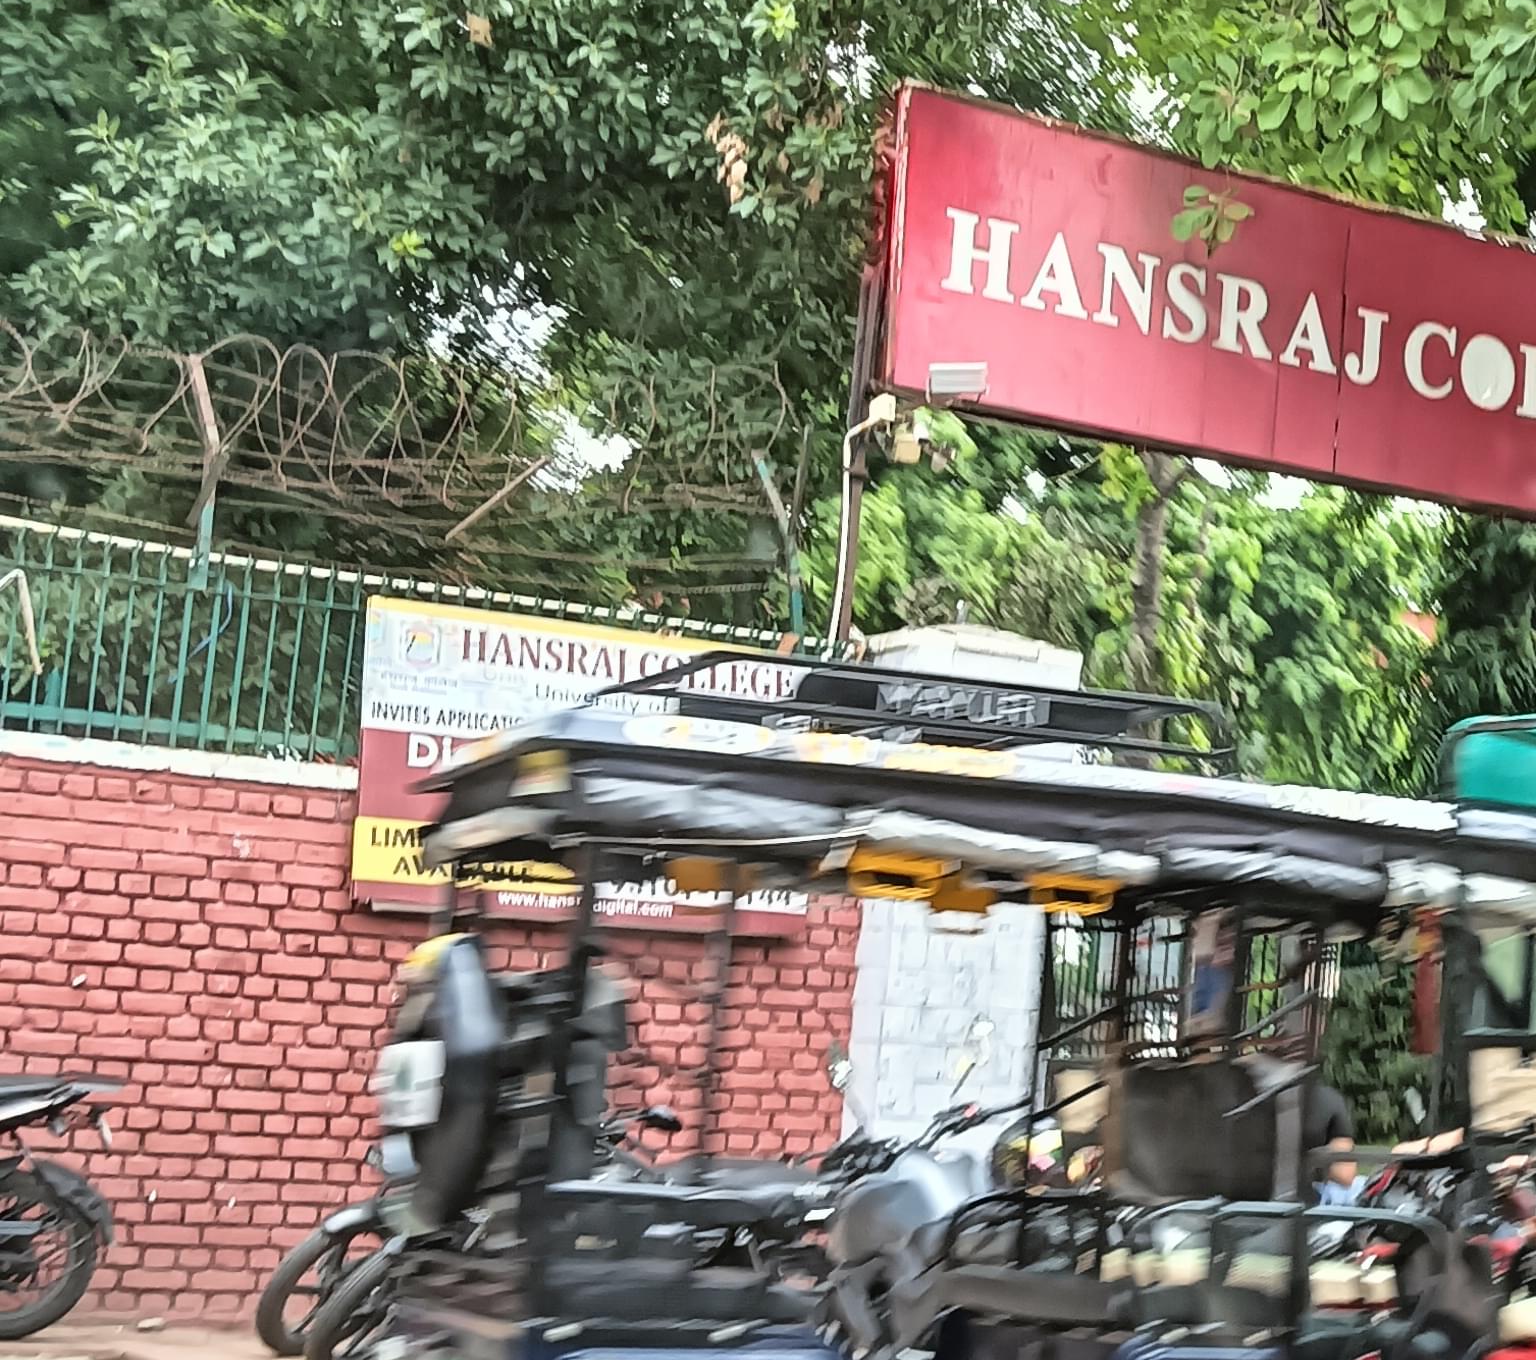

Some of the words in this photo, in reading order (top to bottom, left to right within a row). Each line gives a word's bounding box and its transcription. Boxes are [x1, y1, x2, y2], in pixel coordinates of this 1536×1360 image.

[941, 206, 1389, 385] HANSRAJ
[462, 628, 626, 684] HANSRAJ
[371, 700, 431, 725] INVITES
